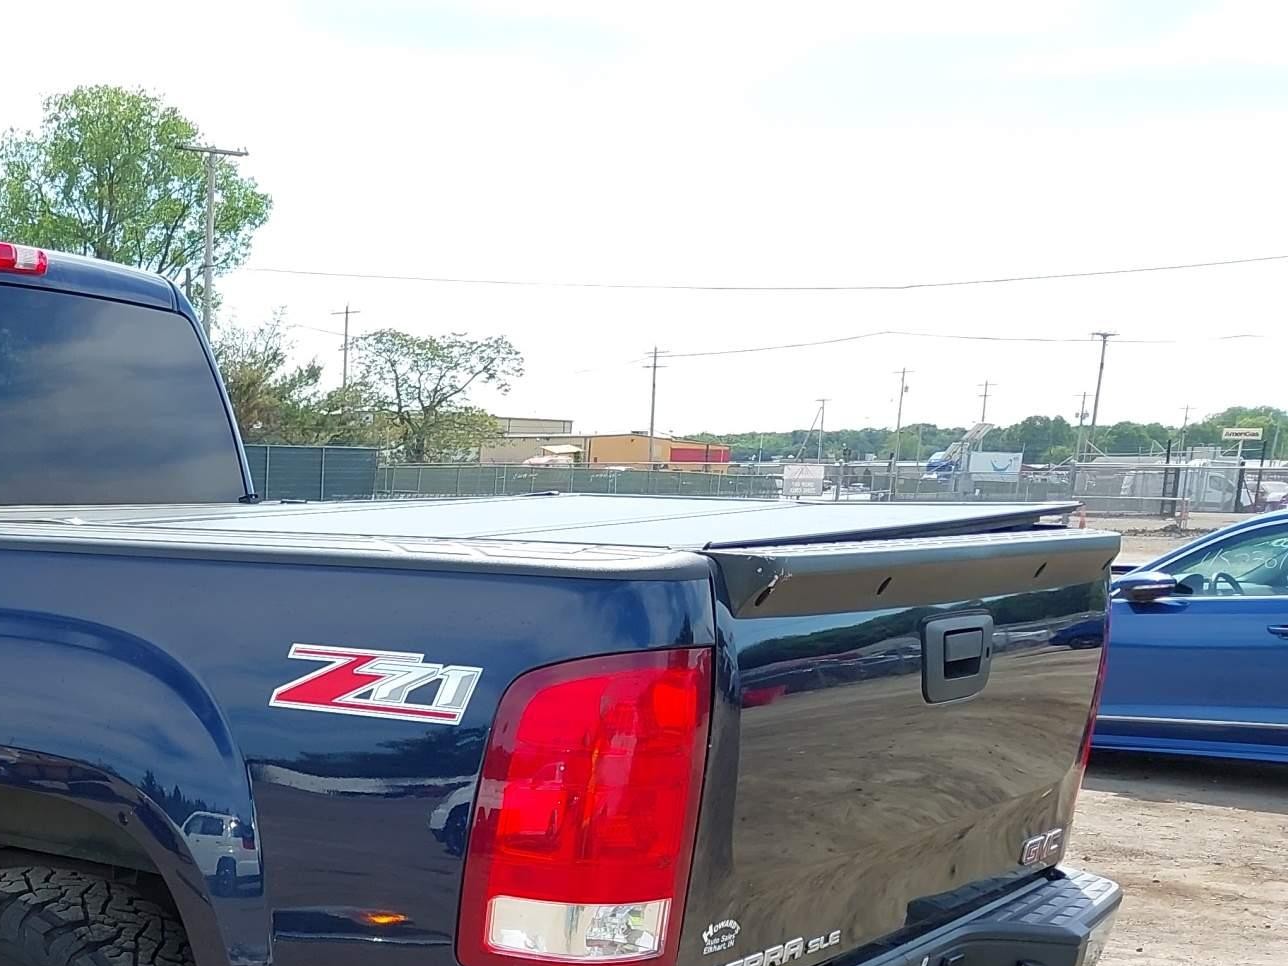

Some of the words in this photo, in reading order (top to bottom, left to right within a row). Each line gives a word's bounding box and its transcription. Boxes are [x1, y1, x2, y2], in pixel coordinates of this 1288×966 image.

[269, 642, 484, 726] Z71
[1023, 828, 1063, 866] GMC
[705, 937, 720, 947] Auto
[806, 929, 841, 954] SLE
